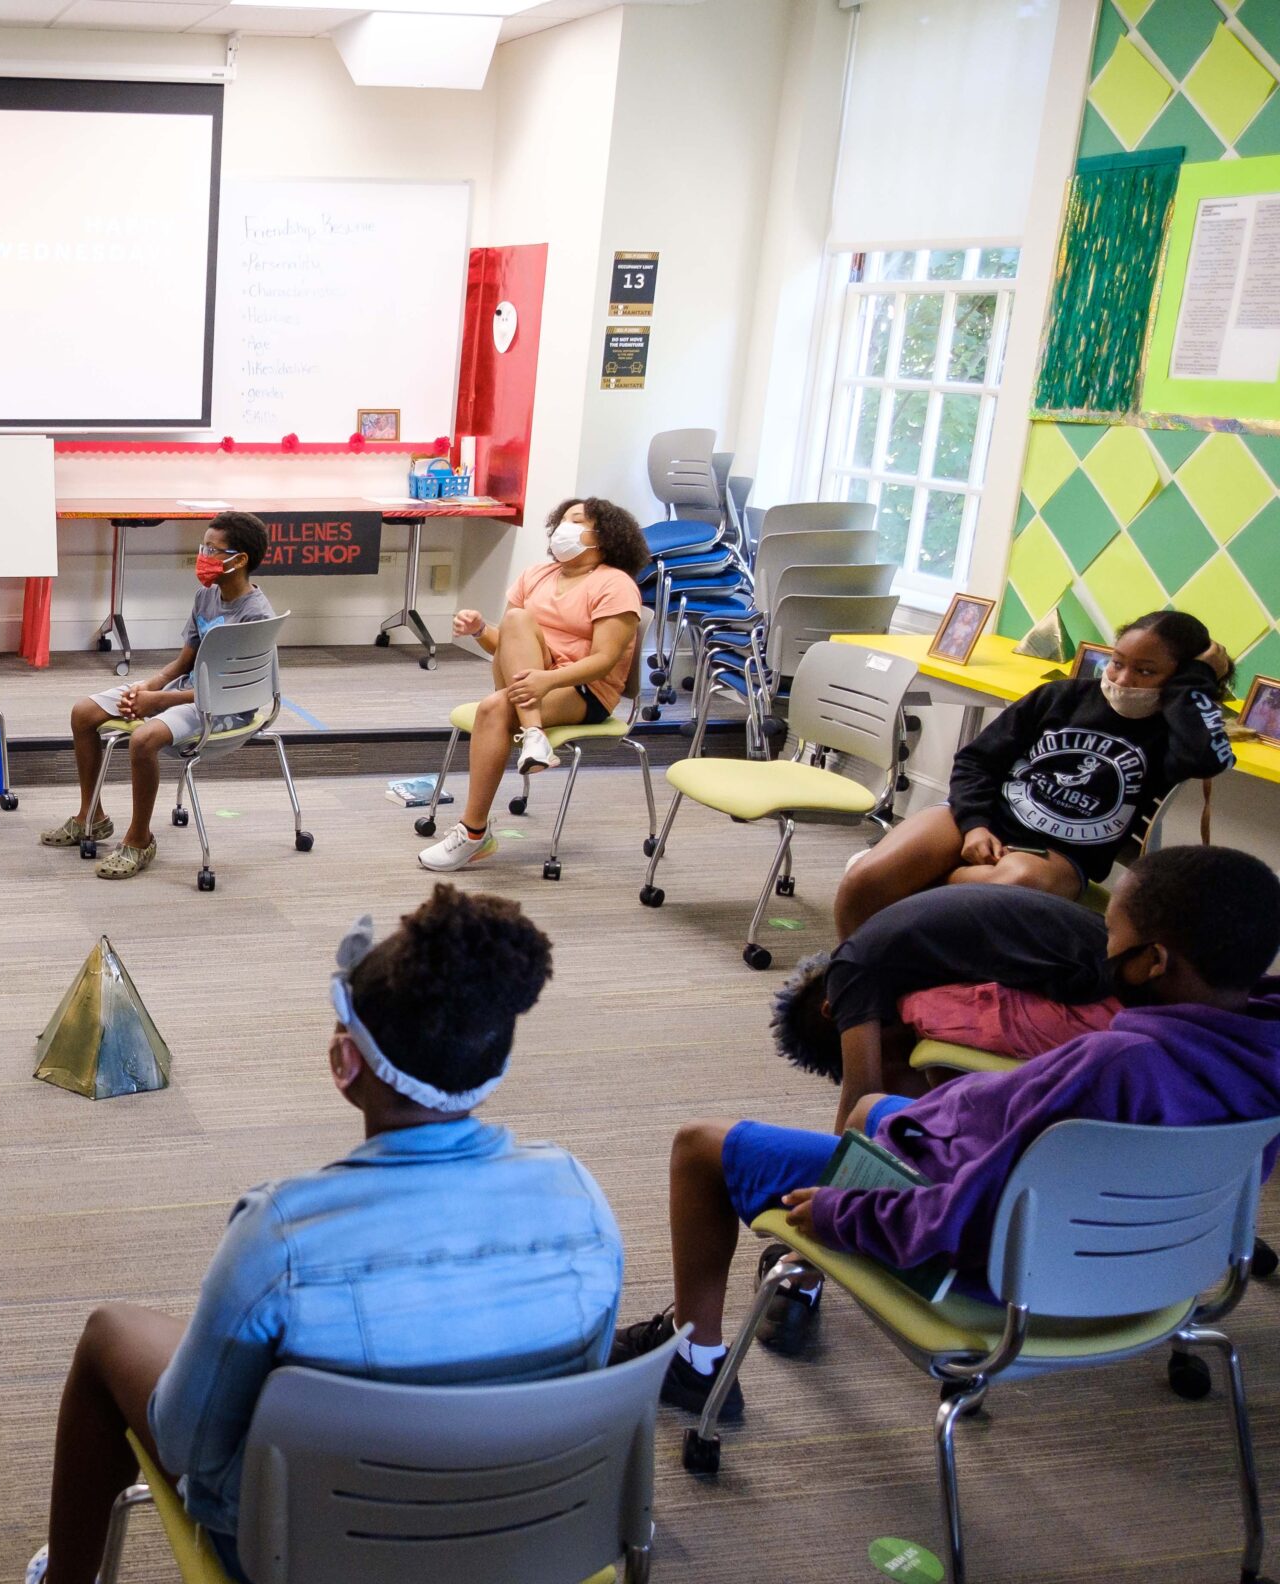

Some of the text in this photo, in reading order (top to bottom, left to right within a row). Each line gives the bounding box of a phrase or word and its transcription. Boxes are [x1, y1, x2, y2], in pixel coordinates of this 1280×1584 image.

[244, 215, 317, 242] Friendship
[623, 273, 645, 289] 13
[267, 522, 353, 541] ILLENES
[302, 544, 361, 564] SHOP
[1026, 809, 1125, 839] CAROLINA
